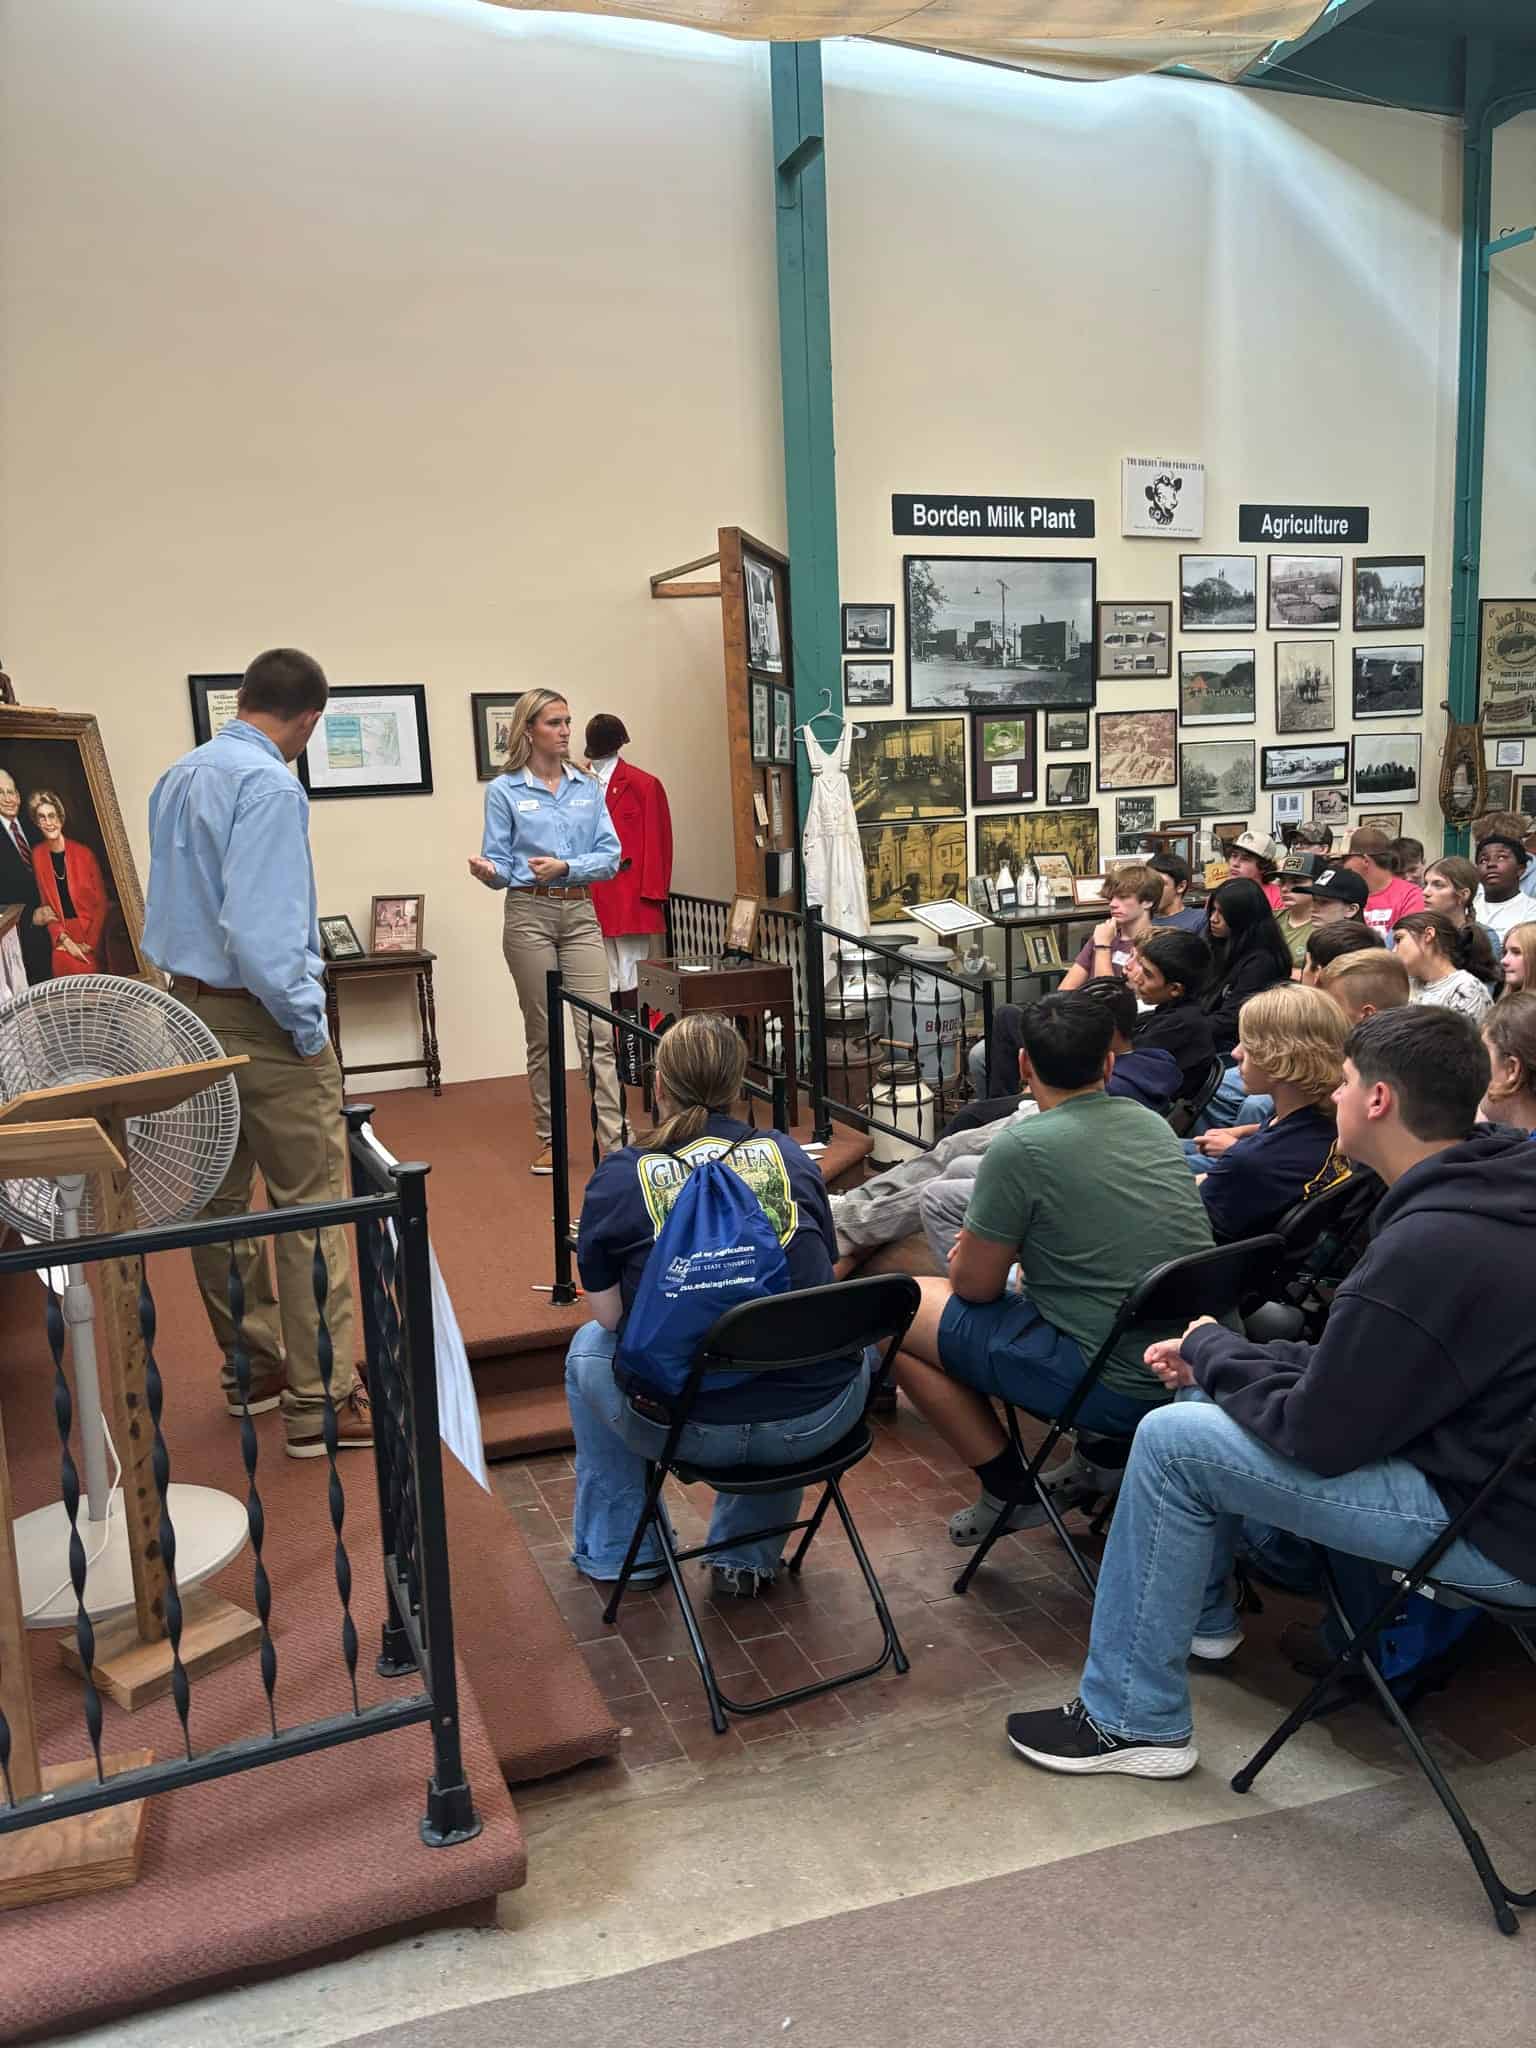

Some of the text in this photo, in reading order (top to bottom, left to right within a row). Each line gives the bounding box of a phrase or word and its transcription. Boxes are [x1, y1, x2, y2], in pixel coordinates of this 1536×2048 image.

[913, 503, 1076, 529] Borden Milk Plant
[1261, 513, 1349, 539] Agriculture
[730, 1147, 777, 1169] FFA
[703, 1263, 722, 1271] STATE
[723, 1259, 756, 1269] UNIVERSITY
